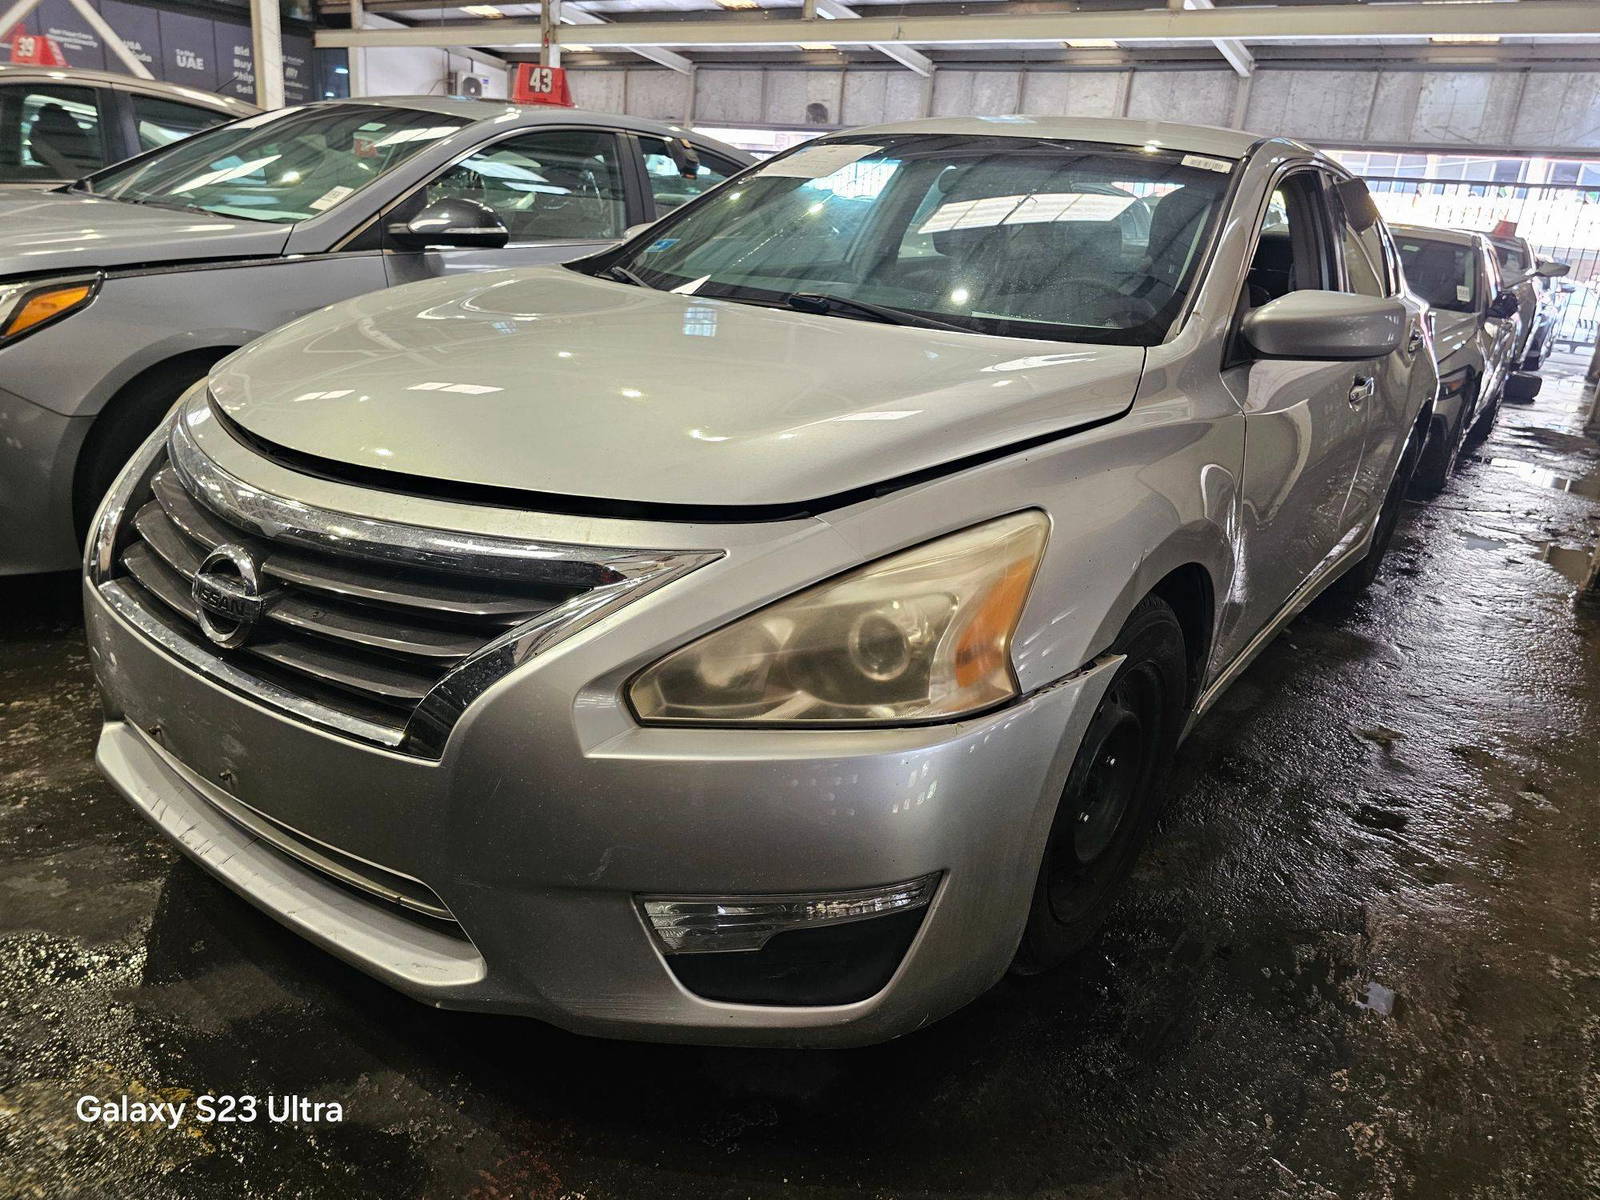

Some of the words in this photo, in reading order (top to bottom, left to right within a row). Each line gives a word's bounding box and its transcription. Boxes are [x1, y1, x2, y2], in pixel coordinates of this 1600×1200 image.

[17, 36, 36, 57] 39
[176, 55, 205, 71] UAE
[233, 58, 252, 72] Buy
[529, 67, 553, 93] 43
[235, 83, 254, 95] Sell
